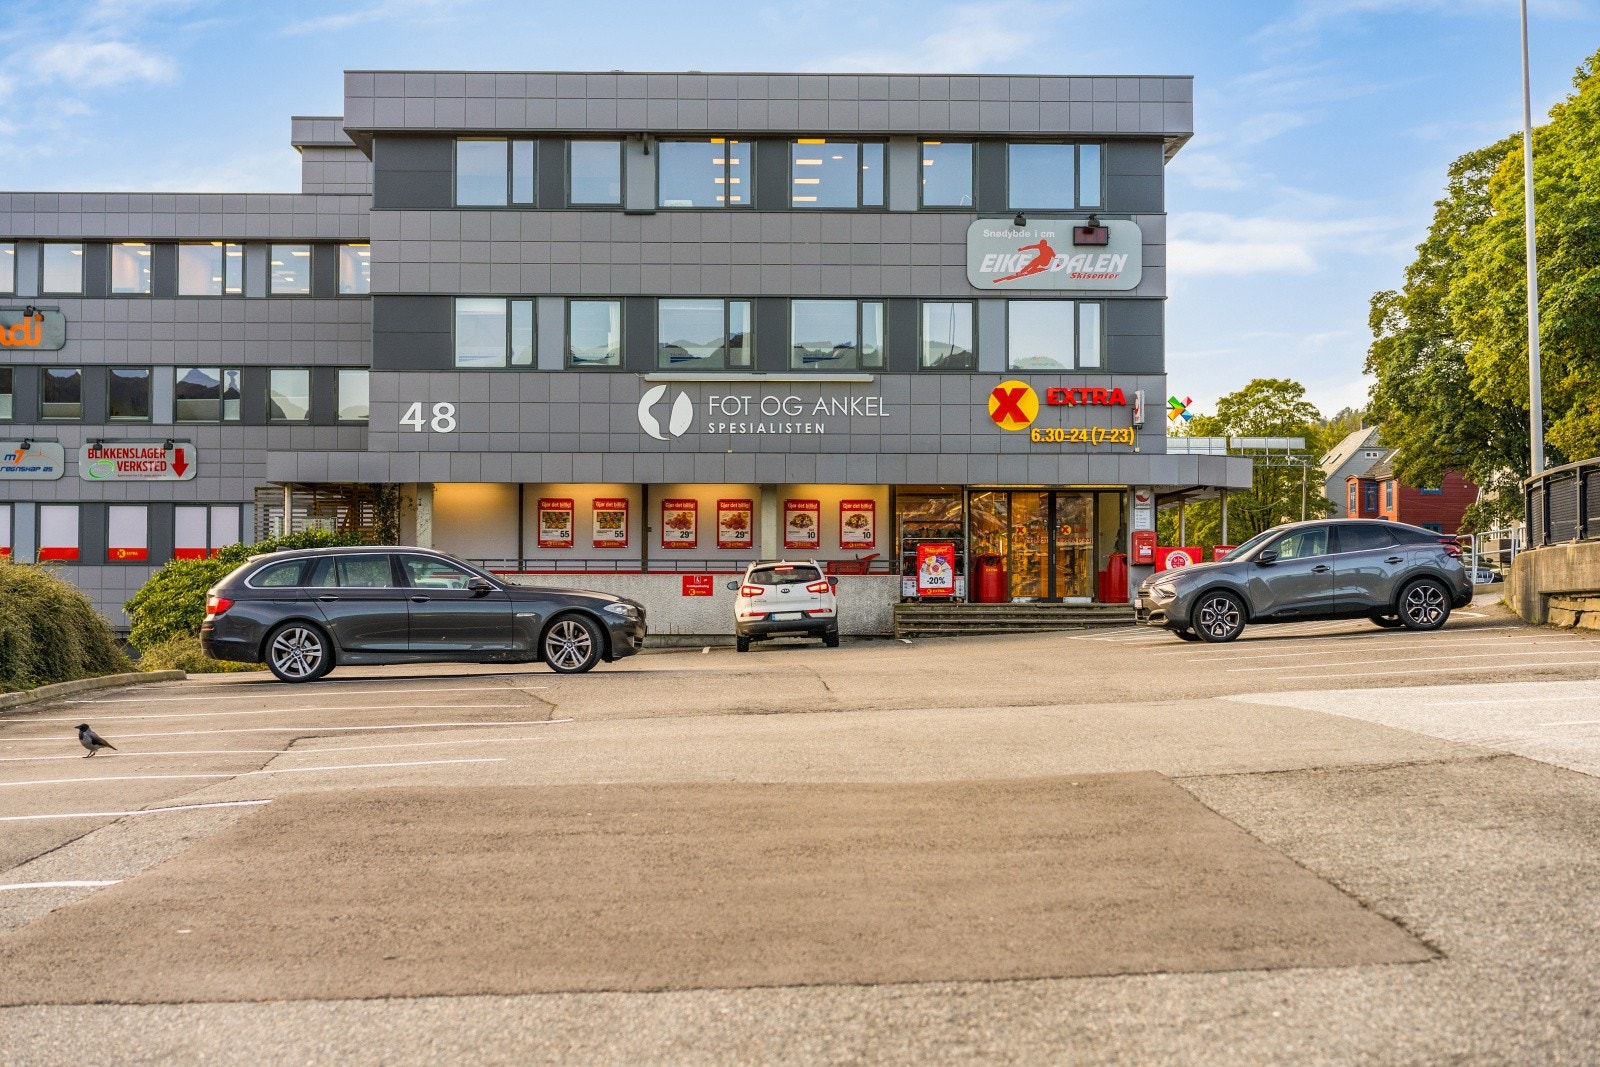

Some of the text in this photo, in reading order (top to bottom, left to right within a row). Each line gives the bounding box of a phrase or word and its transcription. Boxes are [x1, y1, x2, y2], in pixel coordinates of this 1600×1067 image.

[983, 229, 1031, 239] Snødybde
[1034, 229, 1038, 238] i
[1047, 387, 1127, 406] EXTRA
[709, 396, 890, 417] FOT OG ANKEL
[399, 402, 457, 433] 48
[708, 422, 825, 434] SPESIALISTEN
[1031, 426, 1135, 446] 6.30-24 (7-23)
[87, 447, 166, 459] BLIKKENSLAGER
[117, 460, 167, 472] VERKSTED
[560, 530, 570, 538] 55
[614, 530, 624, 538] 55
[680, 530, 690, 539] 29
[735, 530, 745, 539] 29
[807, 531, 816, 539] 10
[862, 531, 871, 539] 10
[926, 576, 946, 585] -20%
